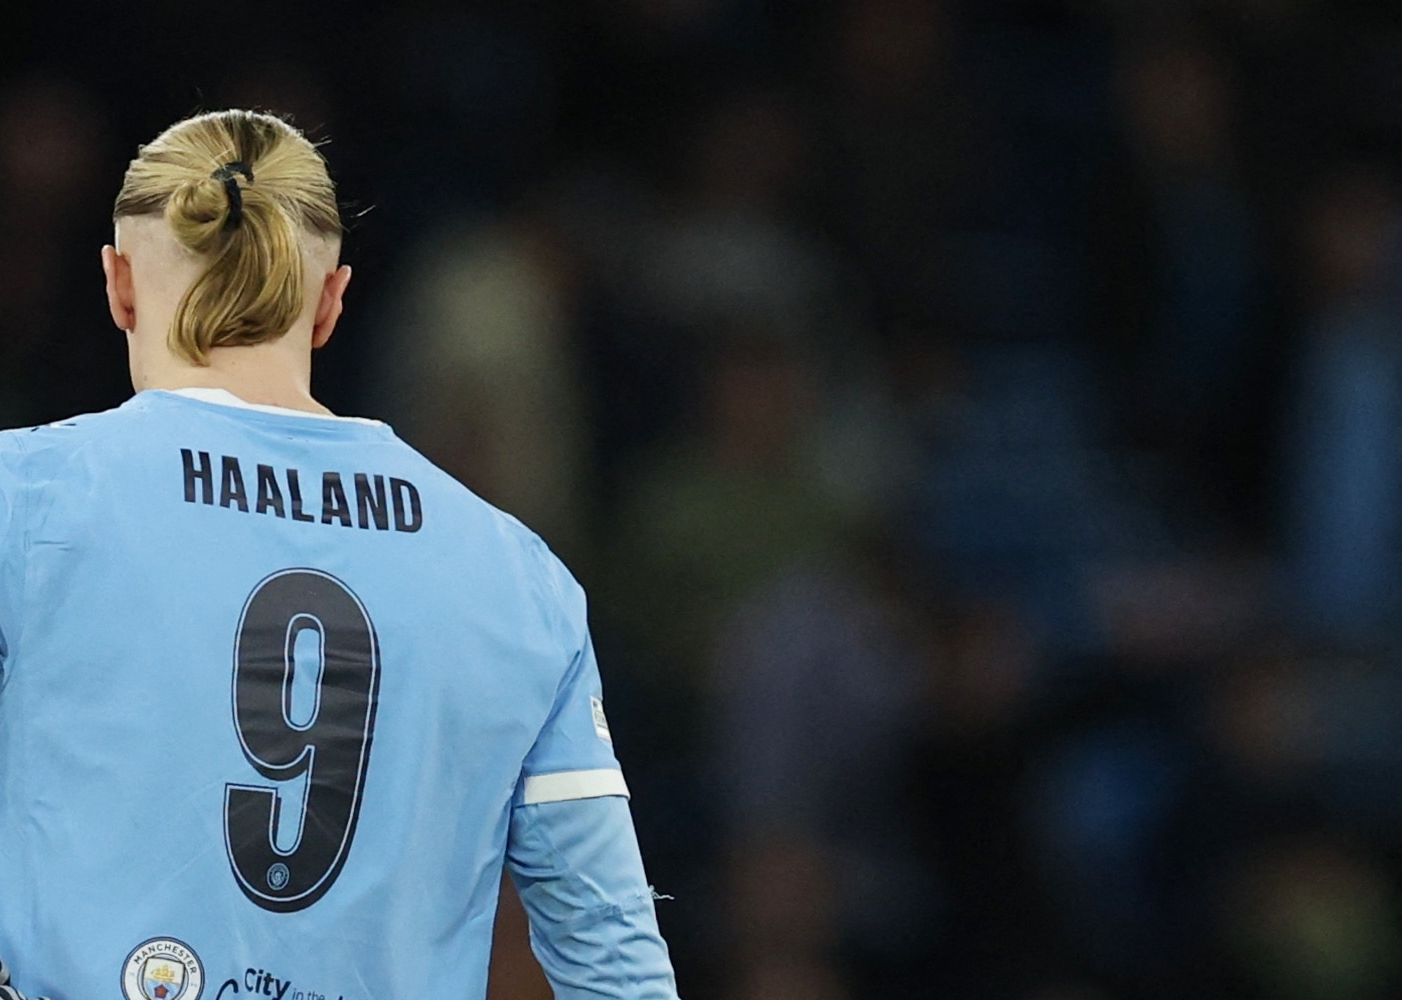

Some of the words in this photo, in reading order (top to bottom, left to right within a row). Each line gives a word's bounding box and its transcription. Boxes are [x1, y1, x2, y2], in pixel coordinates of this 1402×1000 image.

[180, 448, 423, 533] HAALAND
[223, 567, 381, 914] 9
[133, 943, 198, 975] MANCHESTER
